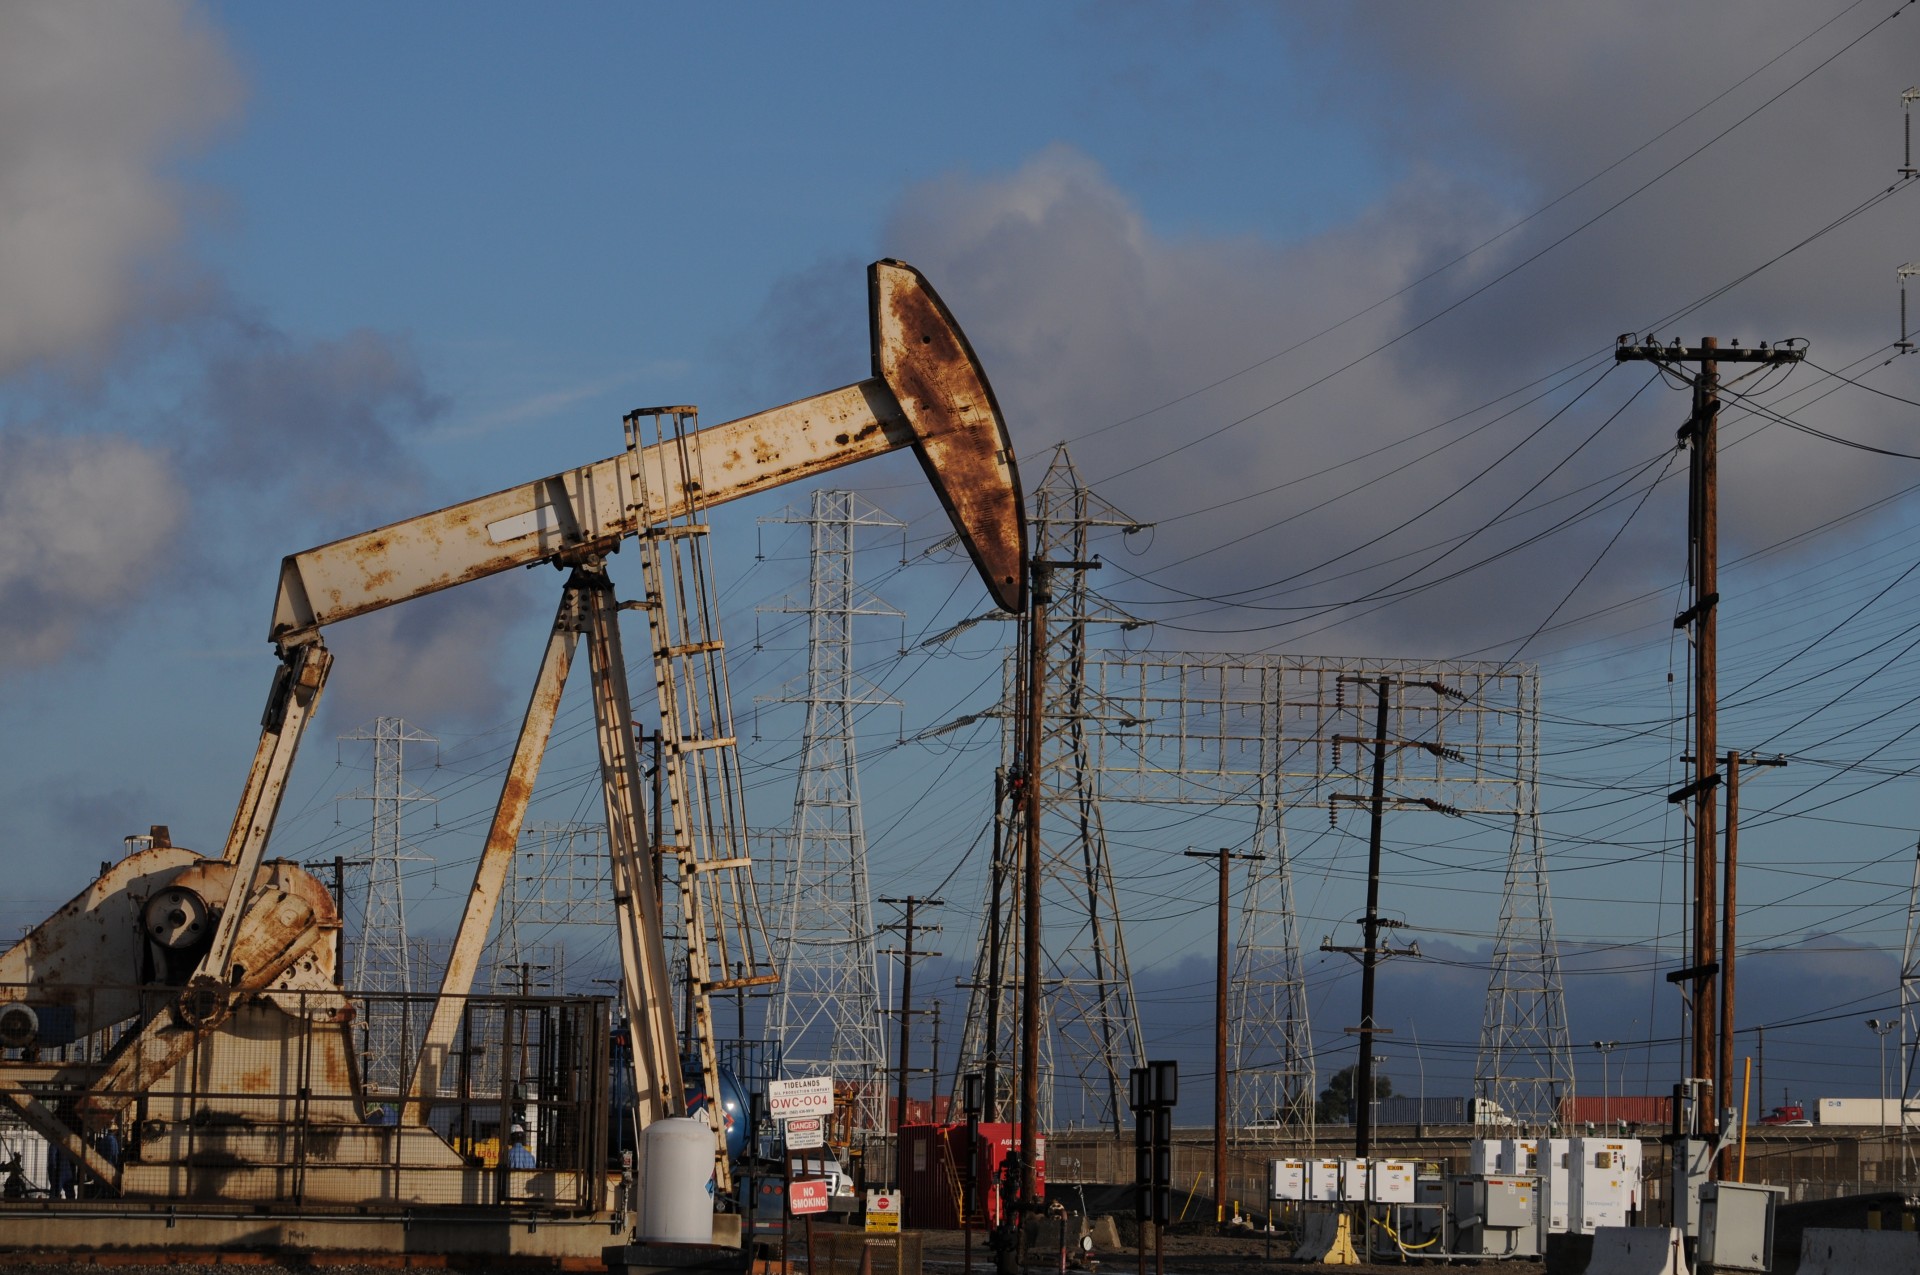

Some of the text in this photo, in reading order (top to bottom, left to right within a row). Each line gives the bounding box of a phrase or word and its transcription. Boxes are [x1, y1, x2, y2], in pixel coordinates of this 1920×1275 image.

[784, 1080, 820, 1089] TIDELANDS
[790, 1121, 817, 1130] DANGER
[803, 1187, 814, 1197] NO
[792, 1197, 826, 1209] SMOKING
